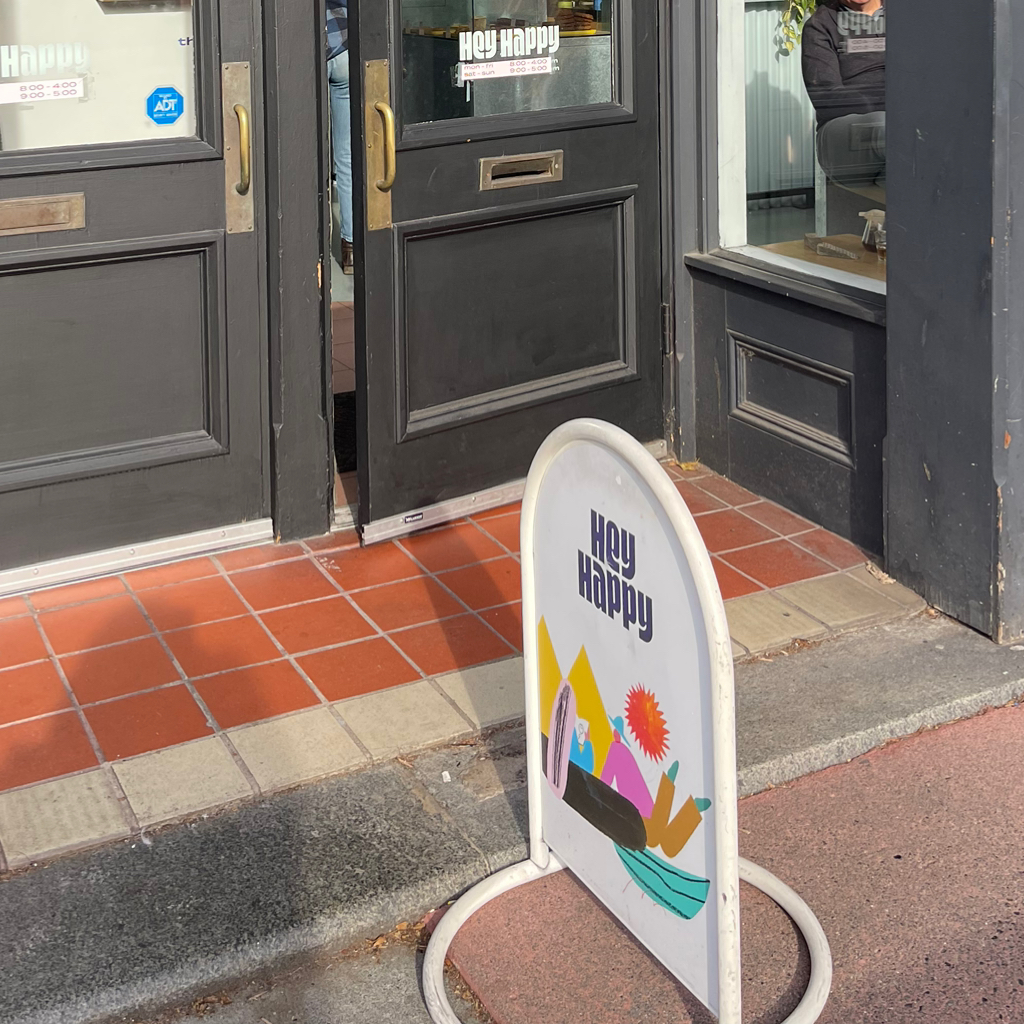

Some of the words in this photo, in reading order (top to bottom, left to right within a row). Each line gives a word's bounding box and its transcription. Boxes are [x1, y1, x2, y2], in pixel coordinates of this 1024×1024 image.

[1, 41, 91, 77] Happy
[458, 29, 497, 61] Hey
[500, 25, 560, 58] Happy
[153, 99, 178, 113] ADT
[590, 508, 636, 581] Hey
[577, 548, 654, 644] Happy
